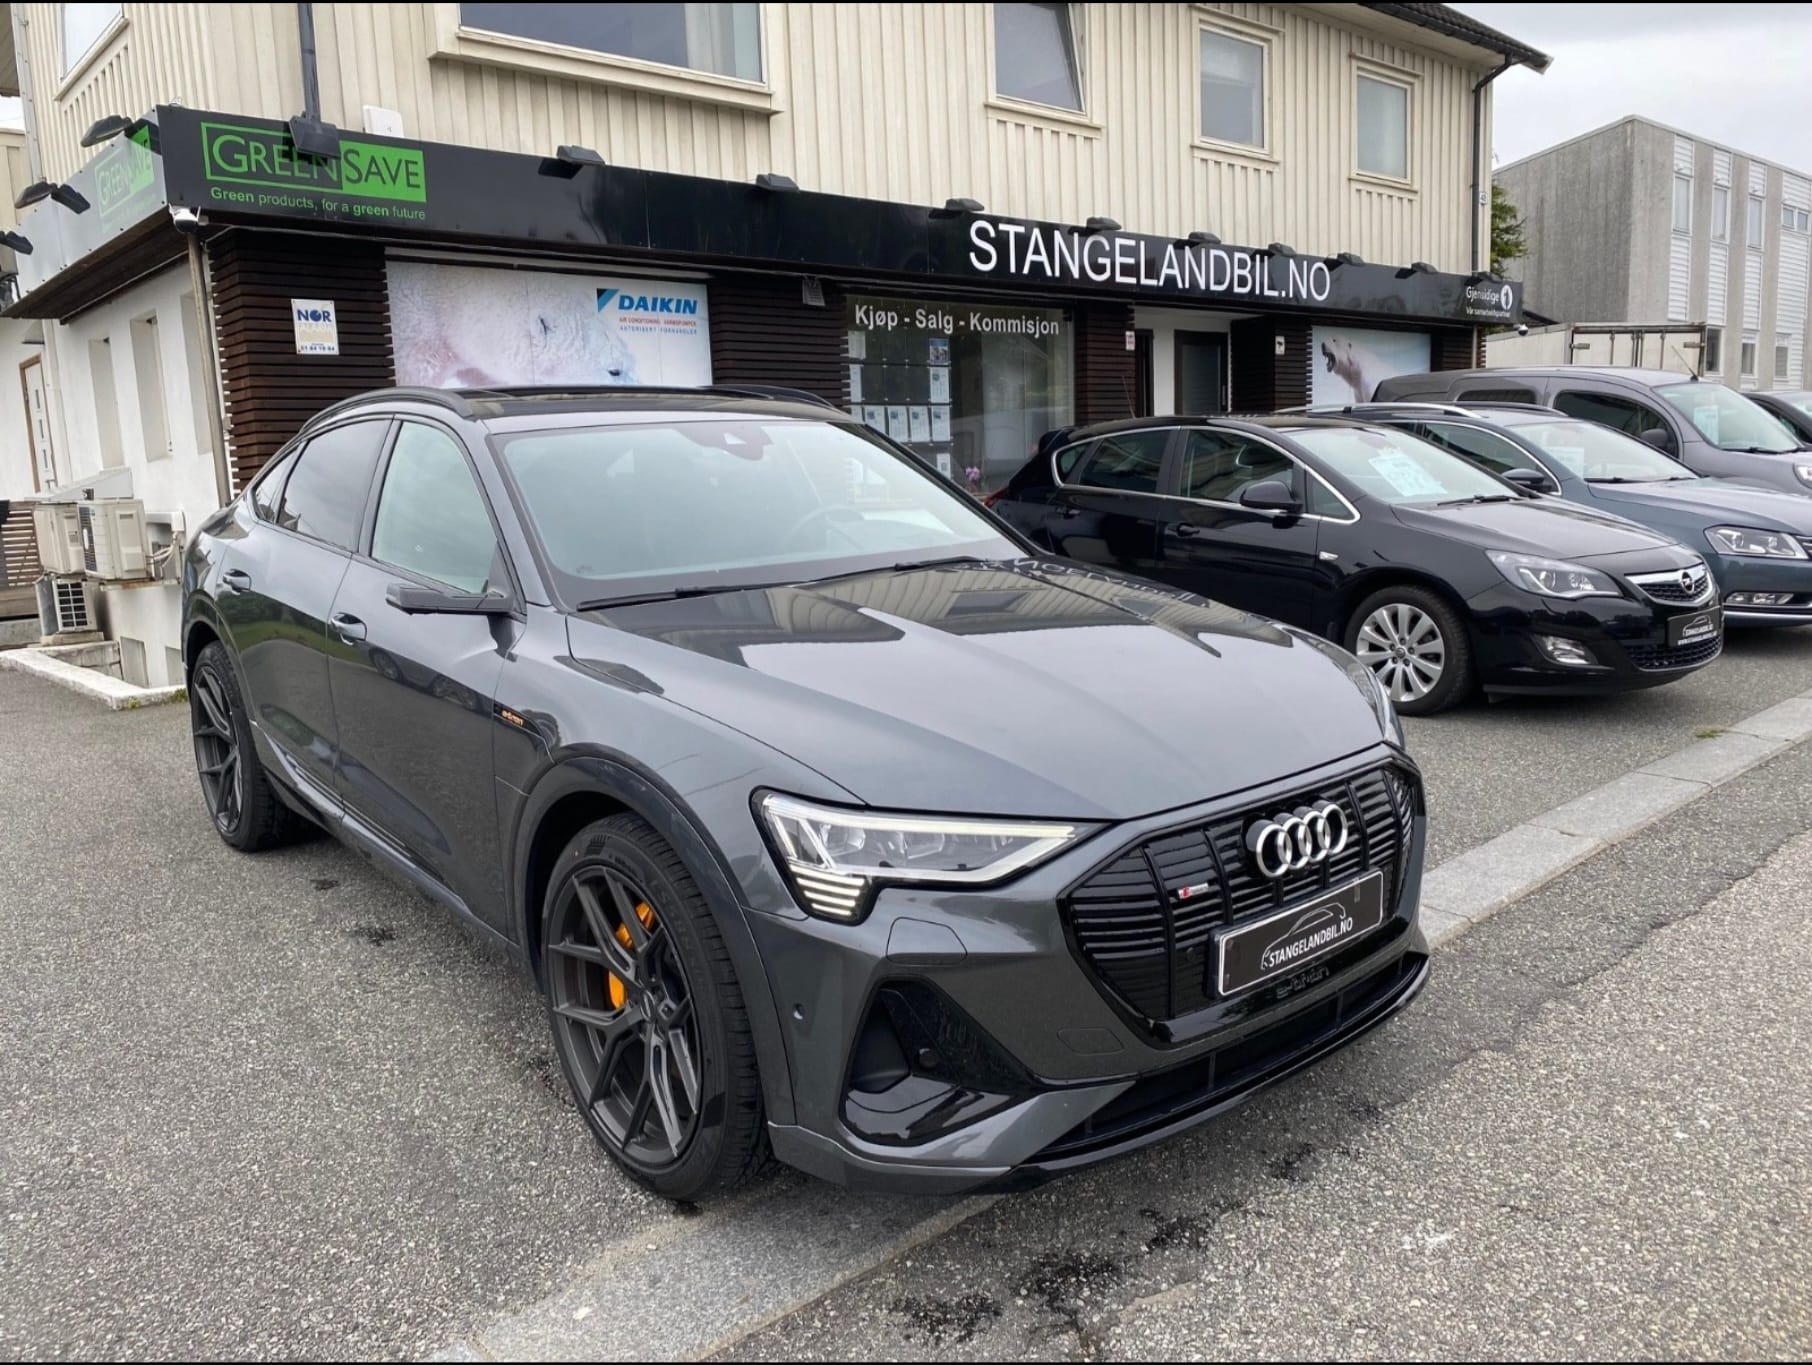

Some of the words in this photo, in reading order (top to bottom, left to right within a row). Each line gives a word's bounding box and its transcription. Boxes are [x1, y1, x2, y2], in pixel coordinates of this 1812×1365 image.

[210, 186, 255, 203] Green
[258, 194, 318, 212] products,
[321, 198, 339, 212] for
[341, 203, 350, 213] a
[352, 204, 389, 217] green
[392, 206, 426, 220] future
[969, 219, 1331, 301] STANGELANDBIL.NO
[618, 295, 698, 315] DAIKIN
[855, 304, 899, 331] Kjøp
[915, 308, 954, 335] Salg
[970, 311, 1060, 340] Kommisjon
[1268, 916, 1354, 968] STANGELANDBIL.NO
